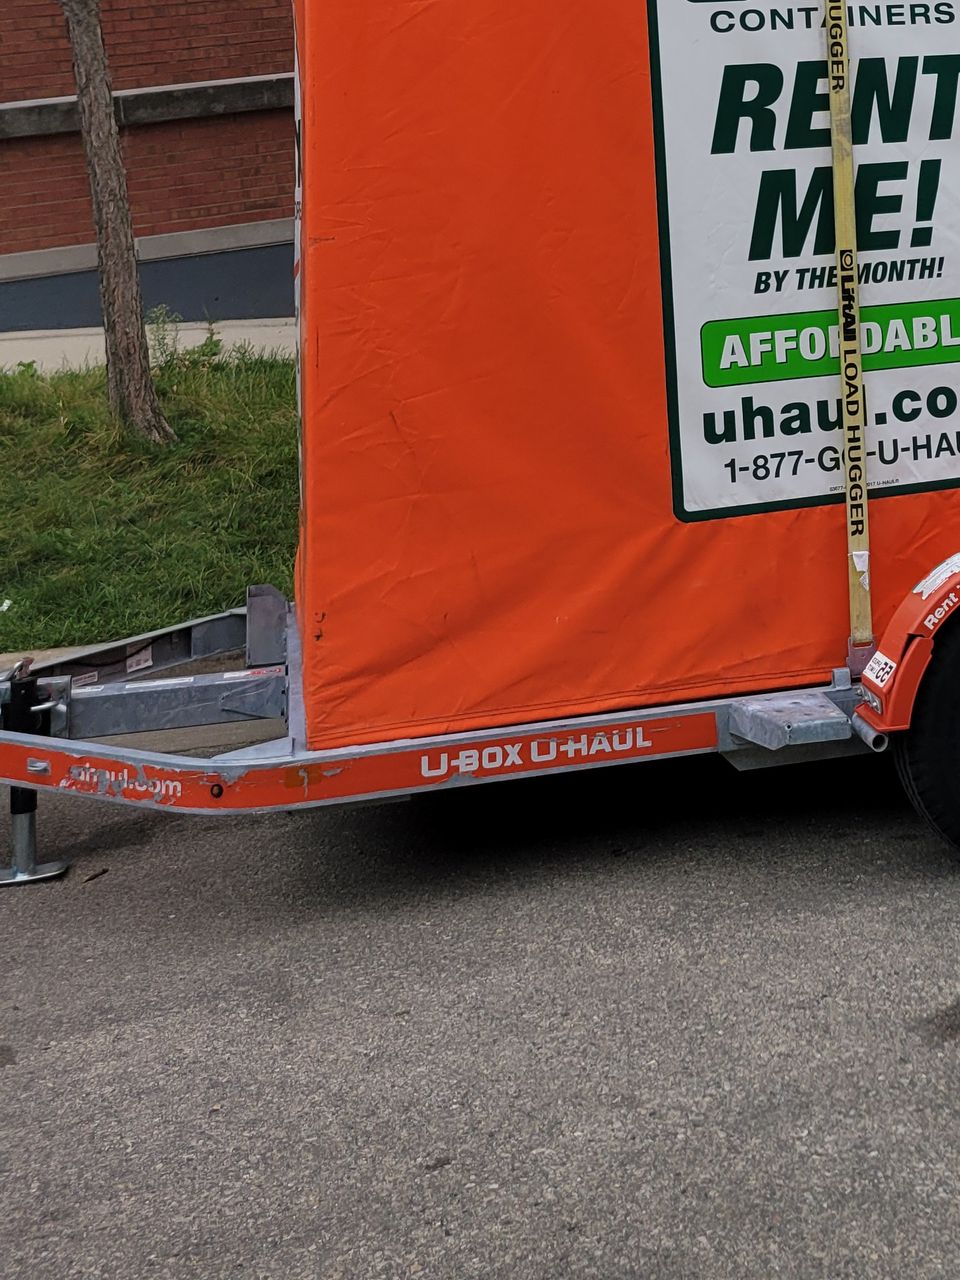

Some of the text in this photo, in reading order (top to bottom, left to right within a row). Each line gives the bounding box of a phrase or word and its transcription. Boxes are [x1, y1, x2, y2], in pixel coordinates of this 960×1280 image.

[710, 2, 956, 33] CONTINERS
[748, 158, 942, 261] ME!
[754, 270, 790, 294] BY
[796, 265, 838, 290] THE
[843, 349, 860, 416] LOAD
[846, 425, 864, 536] HUGGER
[923, 592, 959, 630] Rent
[421, 726, 652, 777] U-BOX U-HAUL
